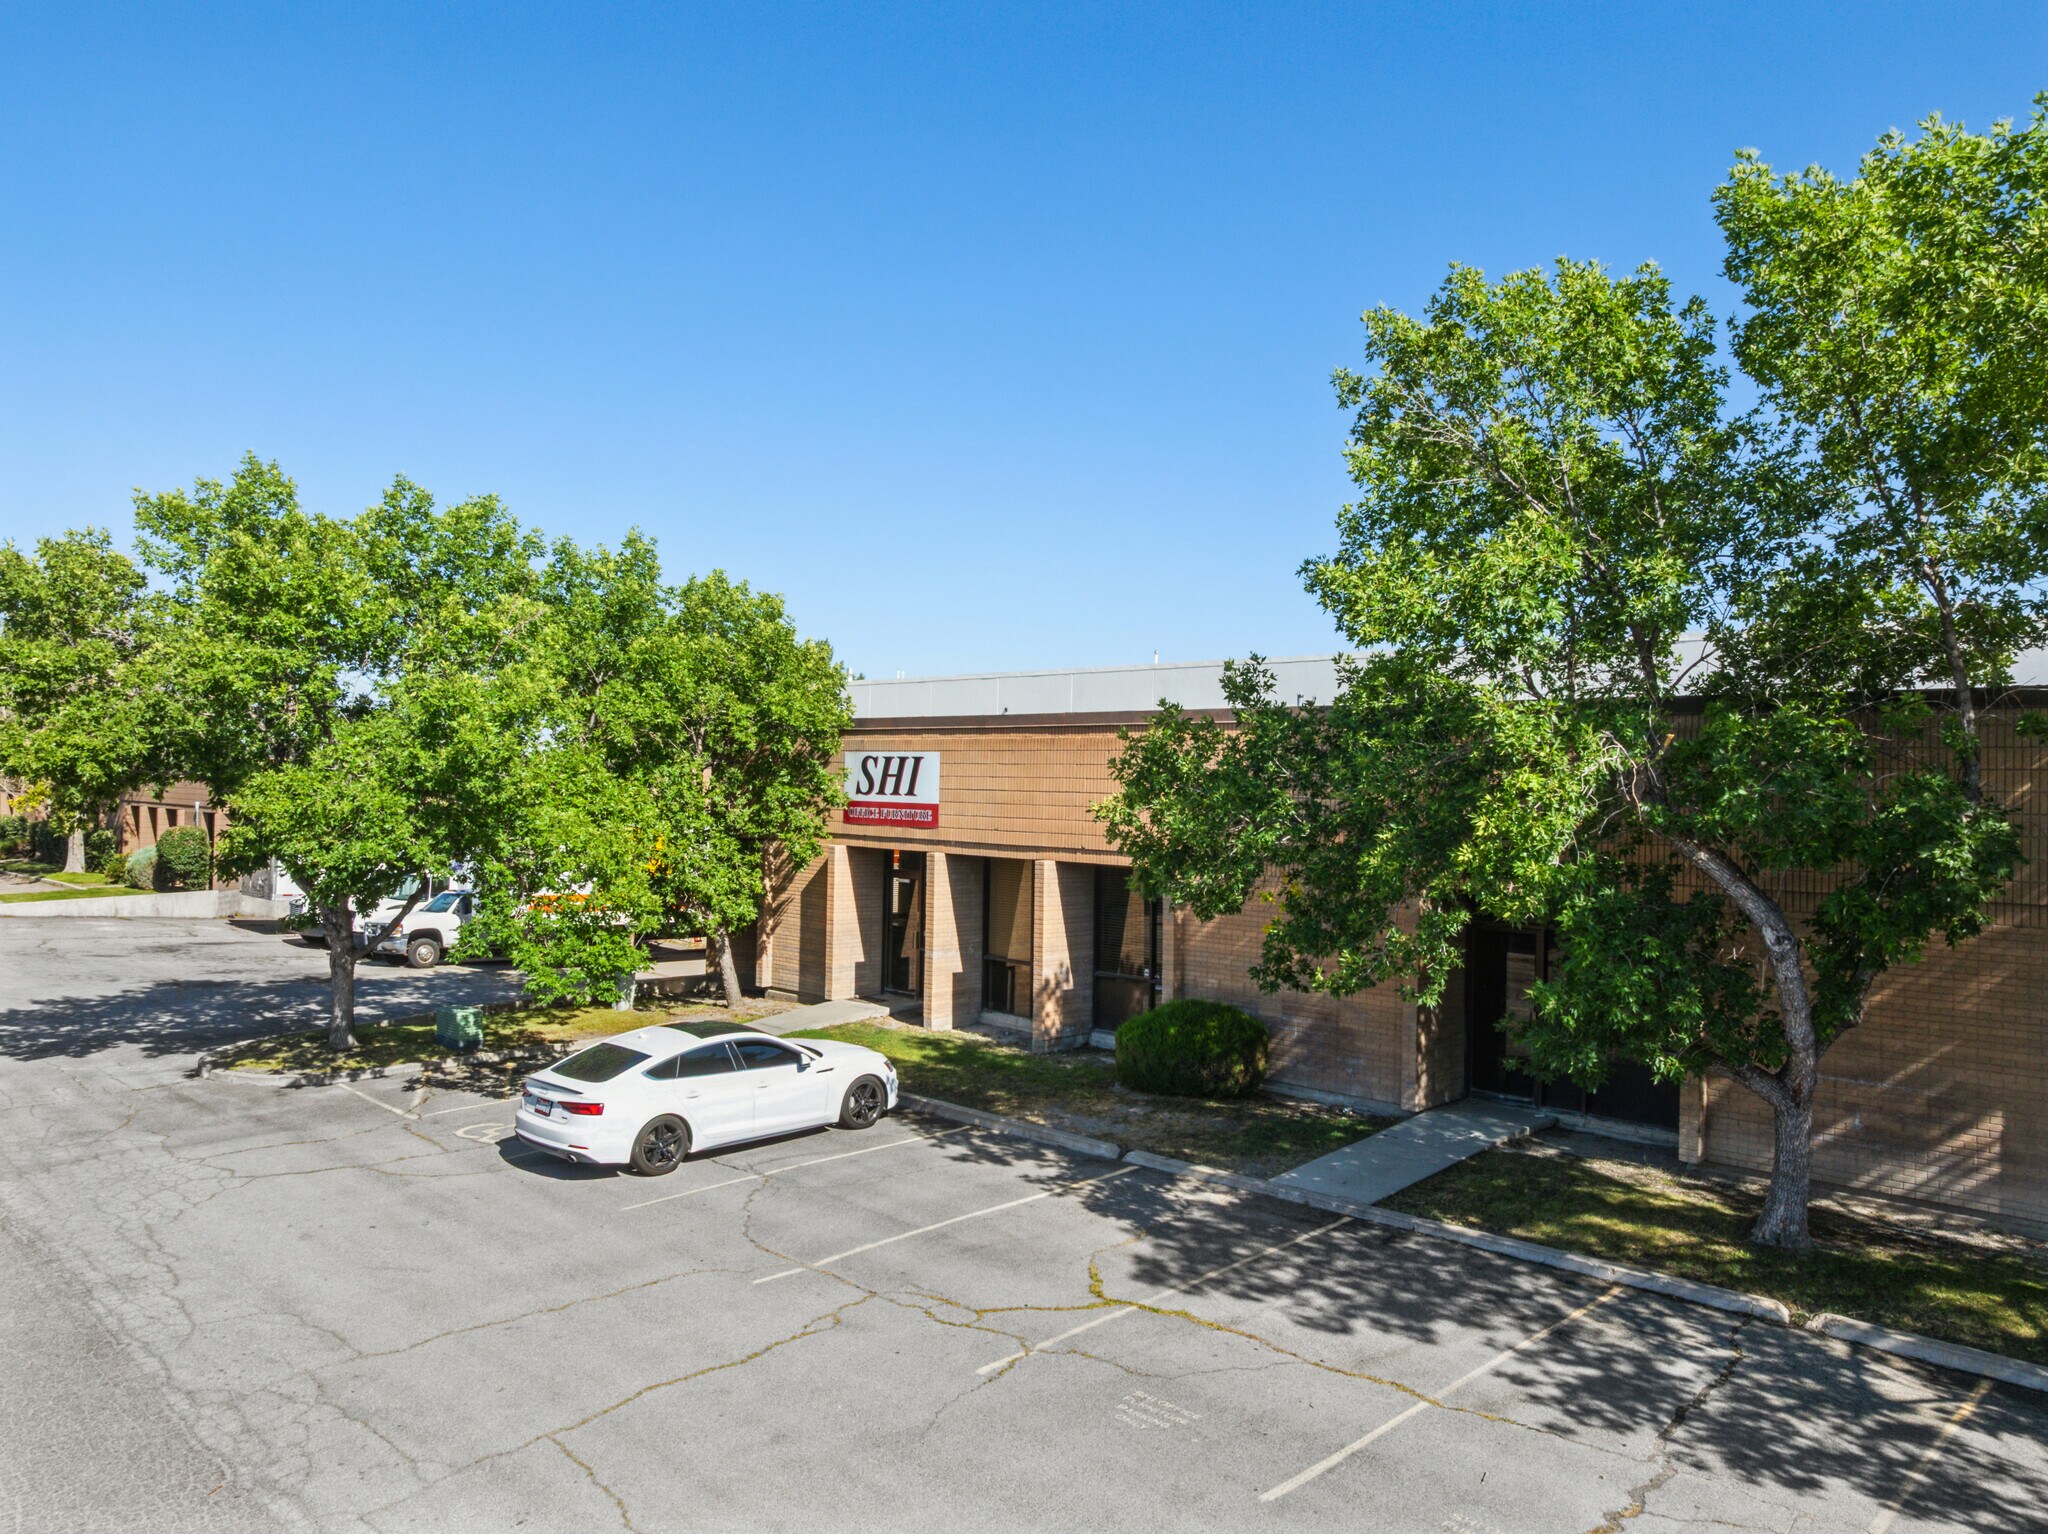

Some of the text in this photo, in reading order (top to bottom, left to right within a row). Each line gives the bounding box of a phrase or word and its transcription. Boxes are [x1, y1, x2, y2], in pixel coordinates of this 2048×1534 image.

[855, 755, 925, 796] SHI
[848, 806, 932, 822] OFFICE FURNITURE
[1113, 1413, 1149, 1429] ONLY
[1115, 1403, 1172, 1428] PARKING
